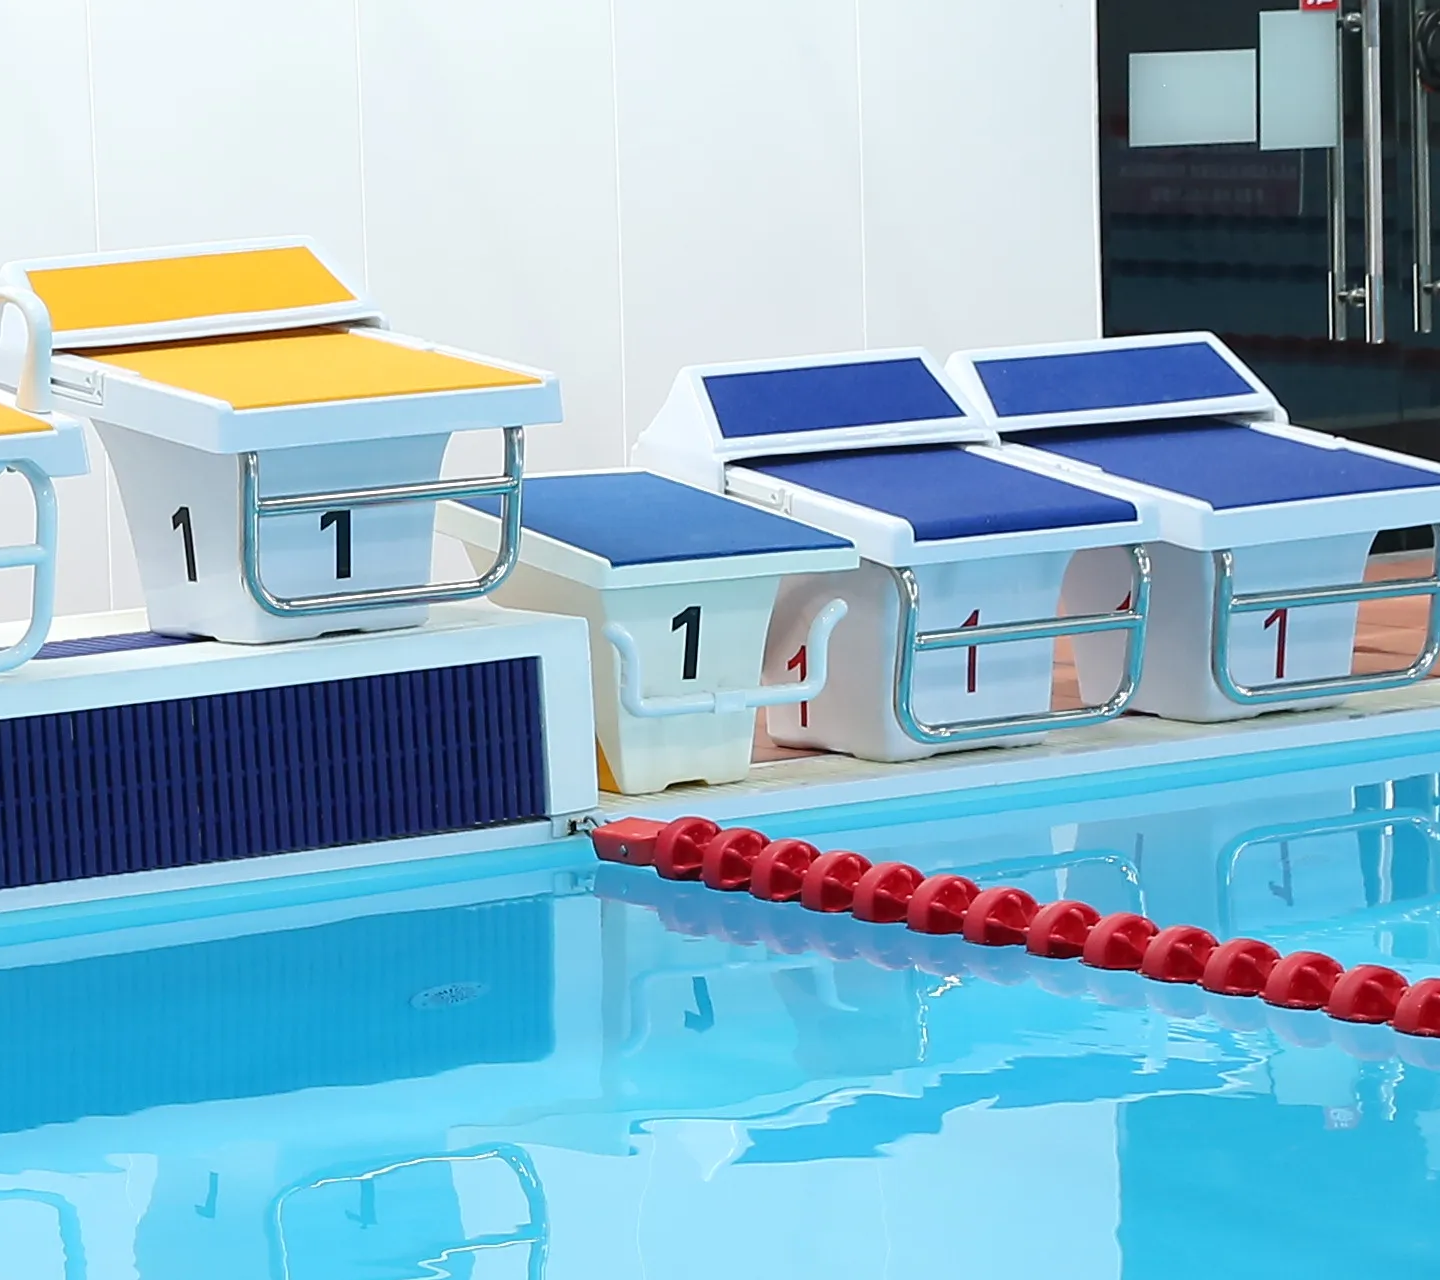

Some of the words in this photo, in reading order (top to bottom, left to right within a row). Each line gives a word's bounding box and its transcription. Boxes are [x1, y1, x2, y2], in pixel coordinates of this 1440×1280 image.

[171, 506, 197, 583] 1
[320, 509, 352, 580] 1
[670, 605, 702, 681] 1
[959, 609, 979, 693] 1
[1262, 608, 1287, 679] 1
[787, 646, 809, 727] 1
